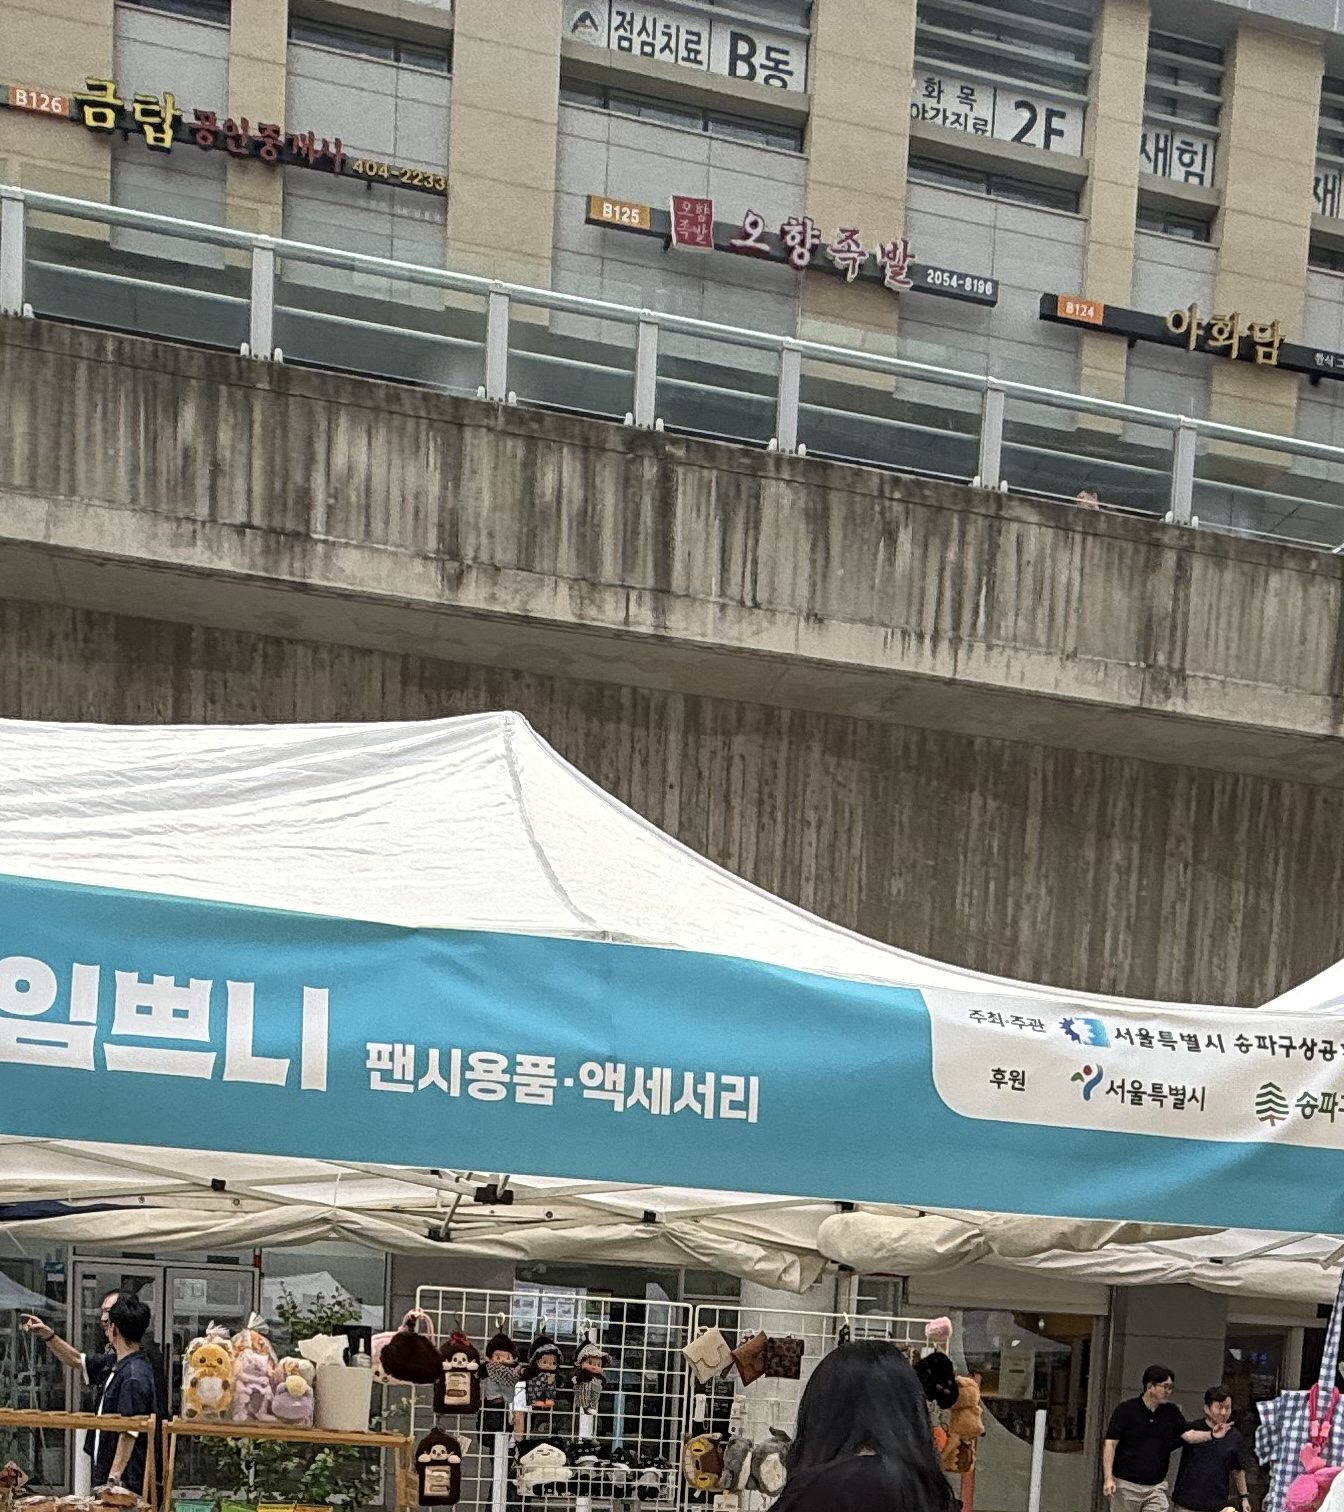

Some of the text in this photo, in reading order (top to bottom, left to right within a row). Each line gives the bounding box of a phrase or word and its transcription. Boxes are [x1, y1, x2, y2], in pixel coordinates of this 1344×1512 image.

[728, 30, 794, 89] B동
[16, 89, 62, 113] B126
[72, 77, 447, 191] 금탑 공인중개사 404-2233
[1010, 99, 1066, 150] 2F
[602, 202, 641, 224] B125
[729, 208, 917, 290] 오향족발
[1066, 301, 1095, 318] B124
[1114, 1027, 1226, 1054] 서울특별시
[989, 1067, 1026, 1092] 후원
[1106, 1078, 1206, 1112] 서울특별시
